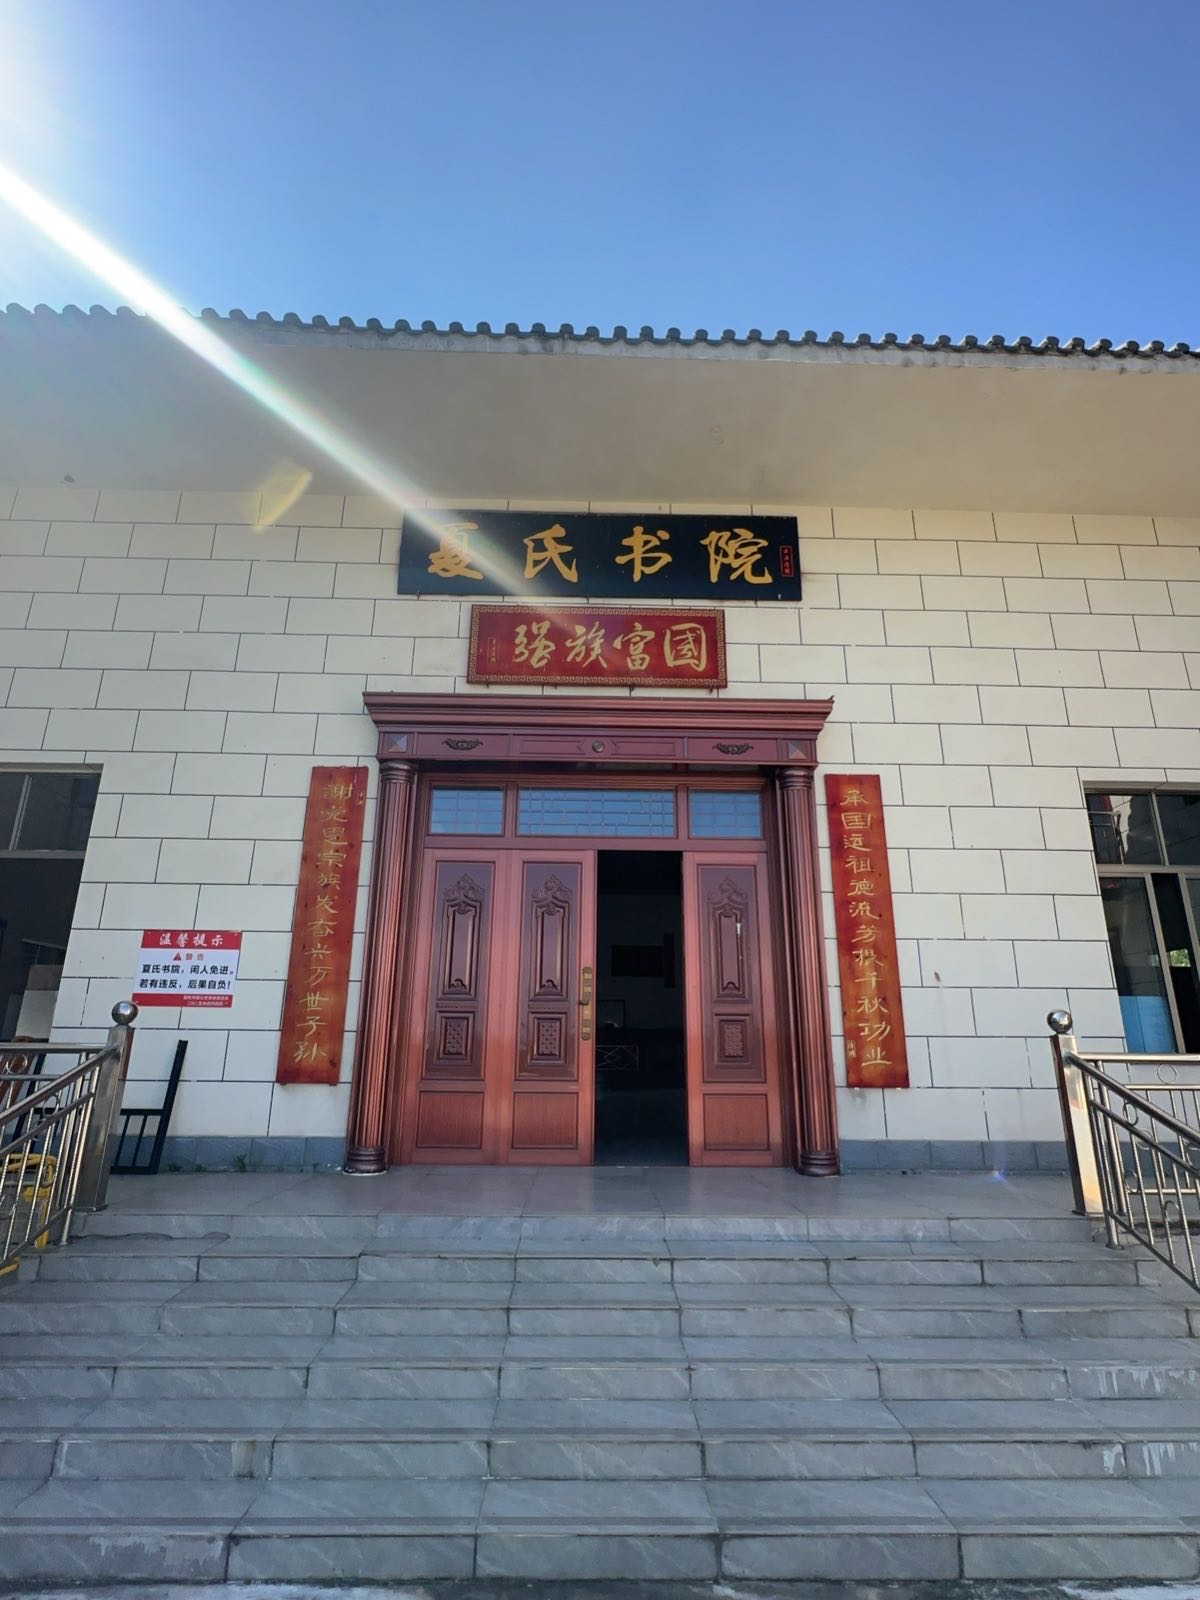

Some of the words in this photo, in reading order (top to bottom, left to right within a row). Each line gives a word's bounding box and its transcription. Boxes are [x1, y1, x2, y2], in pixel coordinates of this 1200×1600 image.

[428, 521, 774, 584] 夏氏书院
[160, 932, 223, 948] 温馨提示
